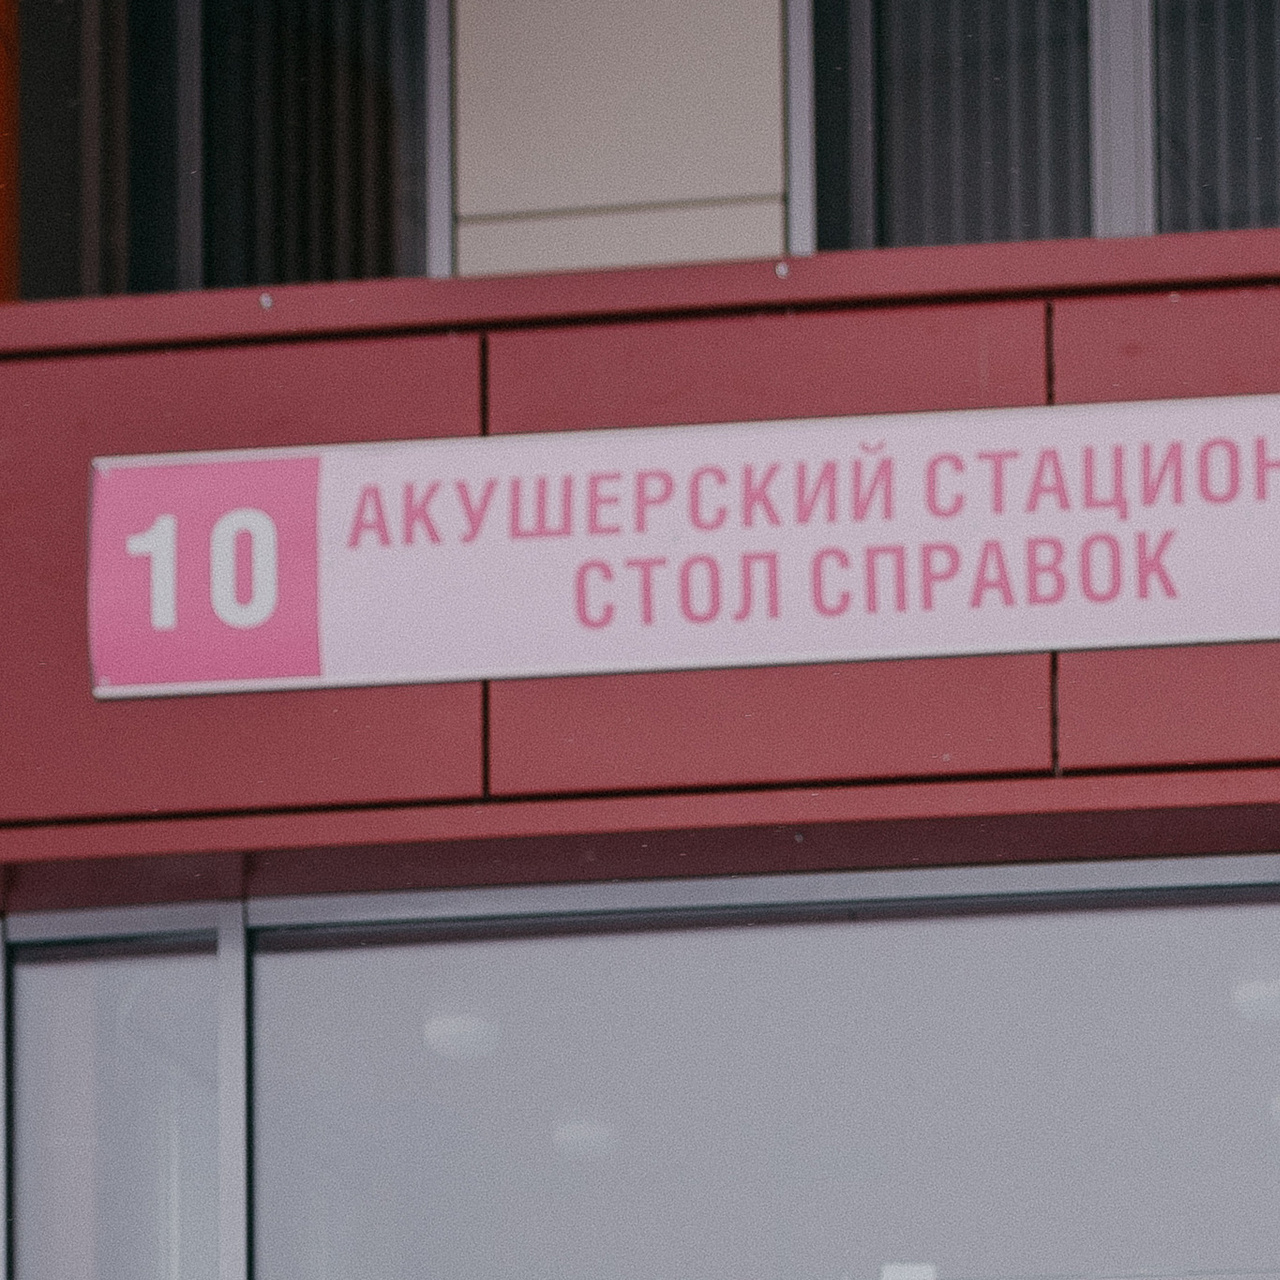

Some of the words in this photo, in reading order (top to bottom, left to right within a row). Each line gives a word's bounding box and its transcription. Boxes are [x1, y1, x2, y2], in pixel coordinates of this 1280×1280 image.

[347, 441, 895, 549] АКУШЕРСКИЙ
[126, 507, 278, 630] 10
[574, 551, 783, 630] СТОЛ
[810, 530, 1178, 617] СПРАВОК
